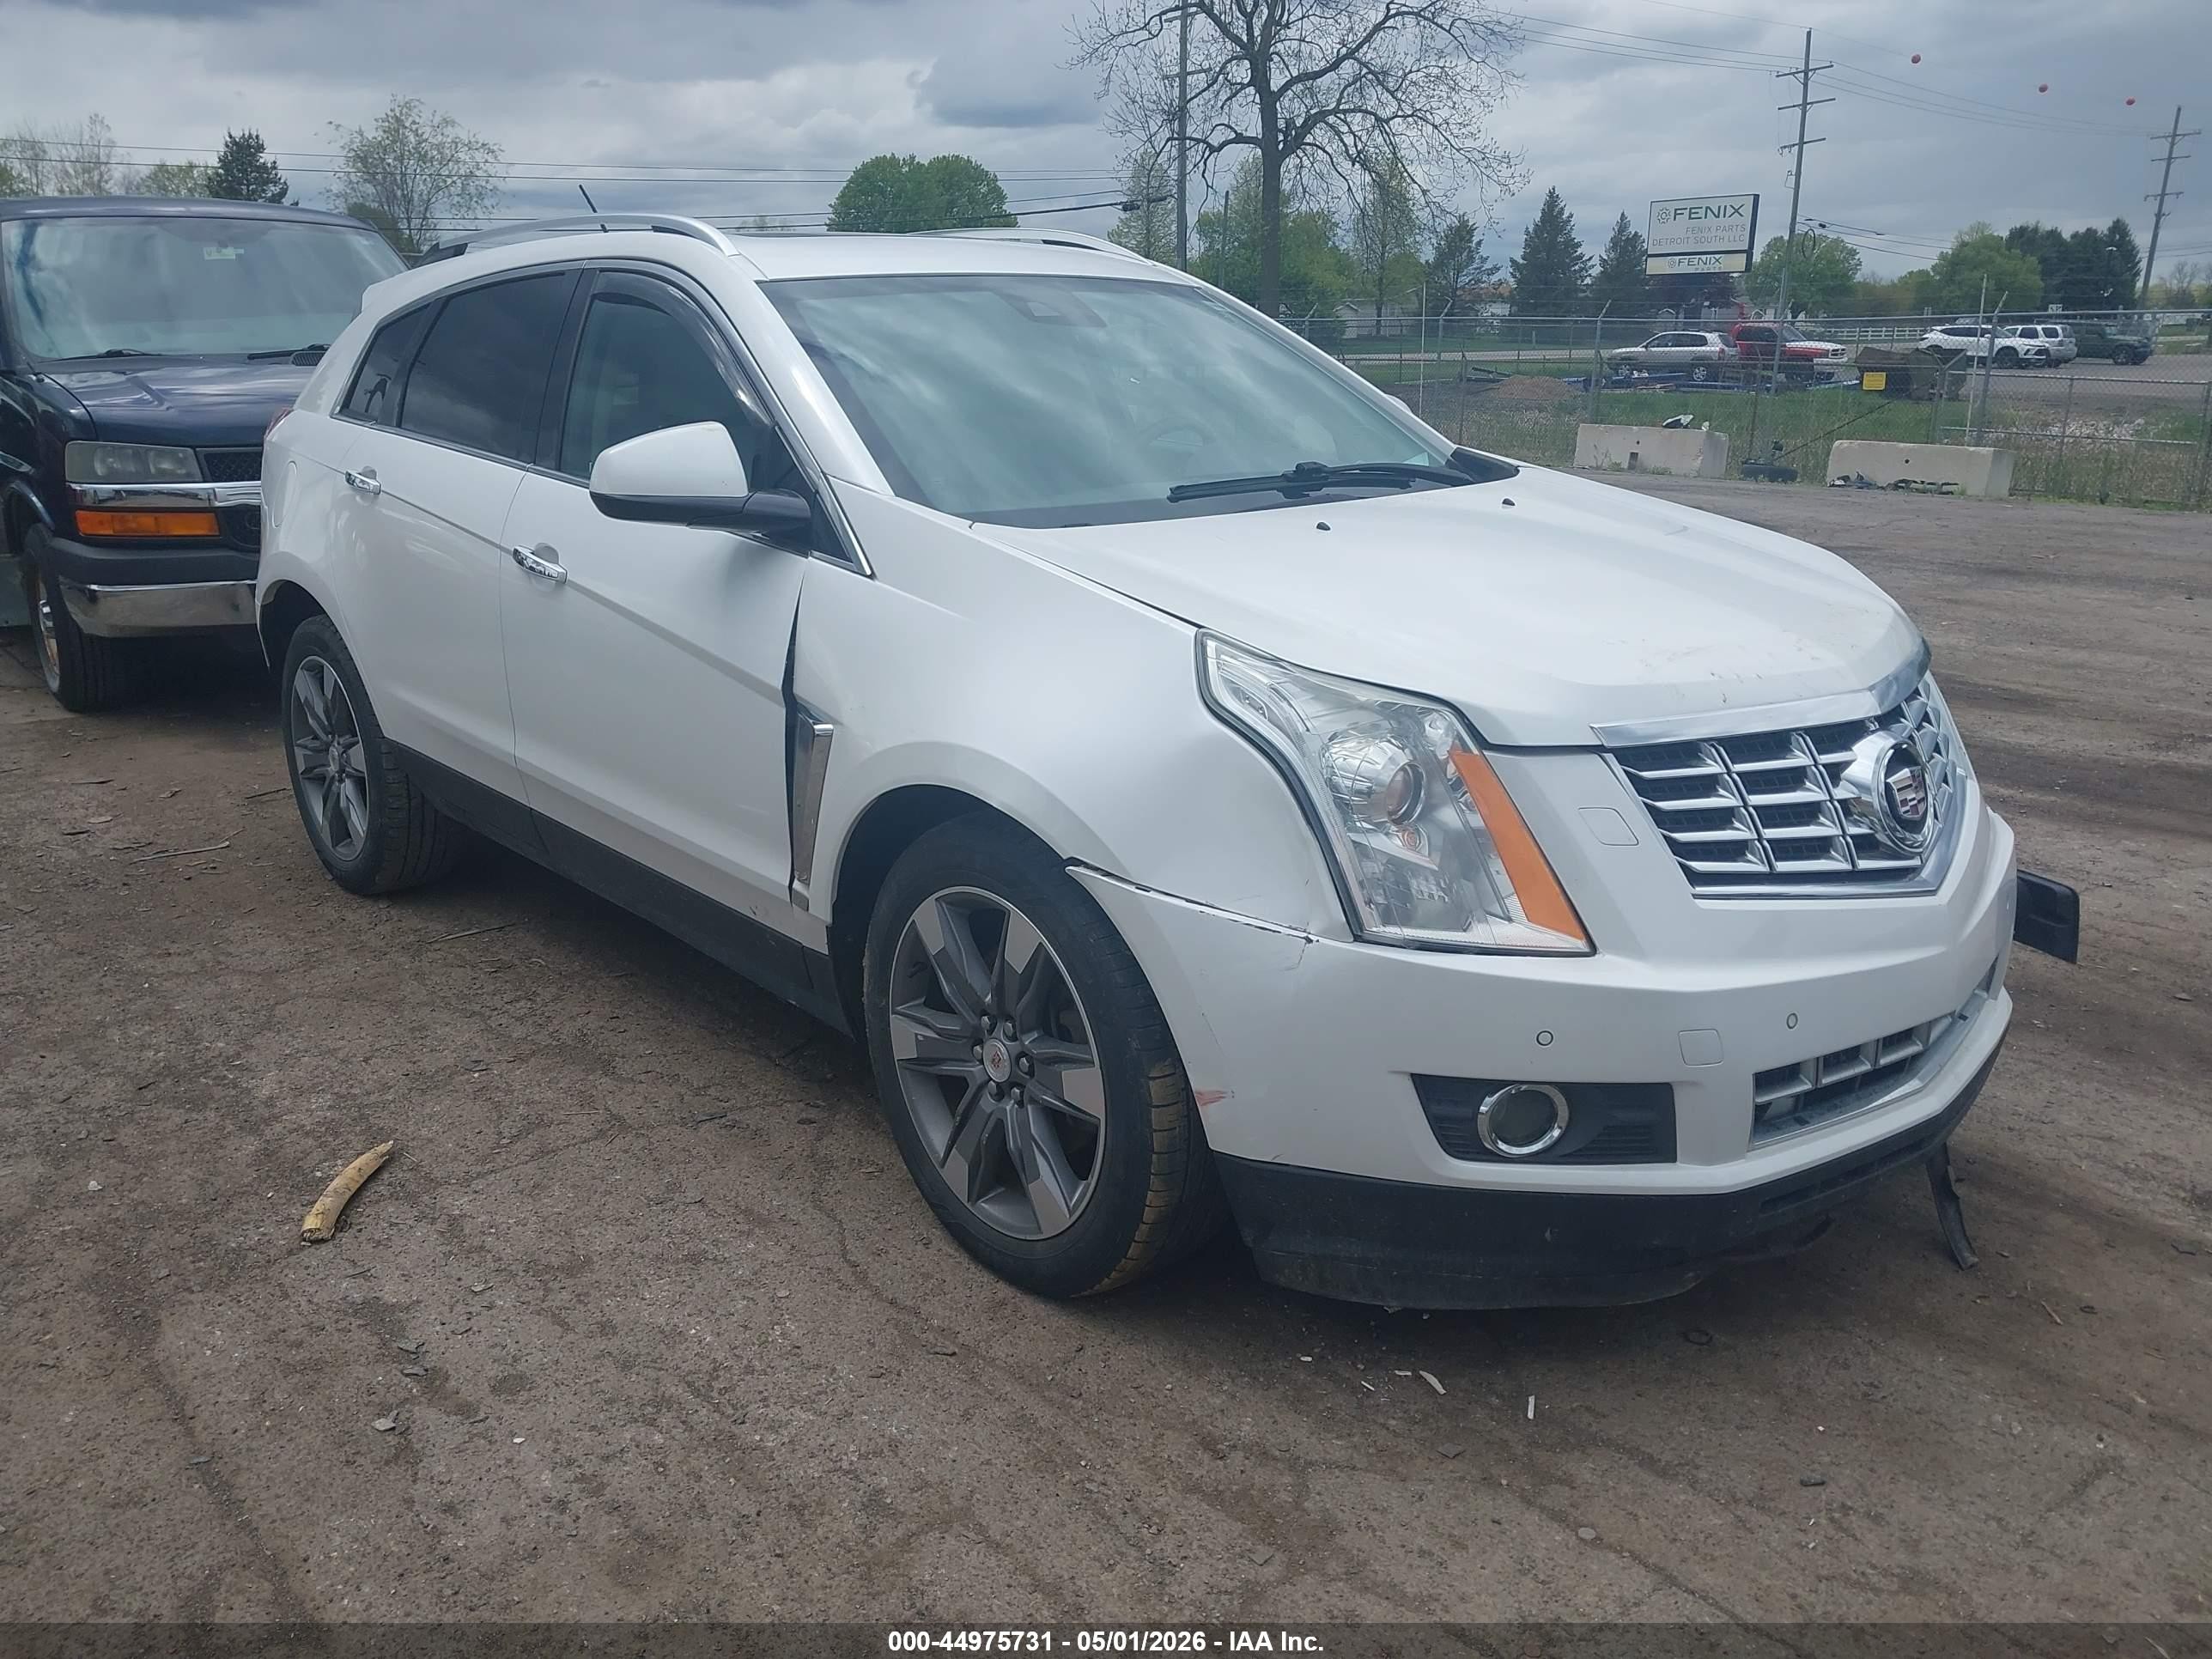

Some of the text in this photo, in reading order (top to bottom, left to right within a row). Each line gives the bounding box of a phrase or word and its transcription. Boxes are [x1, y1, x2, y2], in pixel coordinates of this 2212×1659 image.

[1674, 204, 1746, 222] FENIX
[1686, 224, 1746, 234] FENIX PARTS
[1652, 237, 1690, 246] DETROIT
[1694, 235, 1724, 245] SOUTH
[1678, 256, 1723, 267] FENIX
